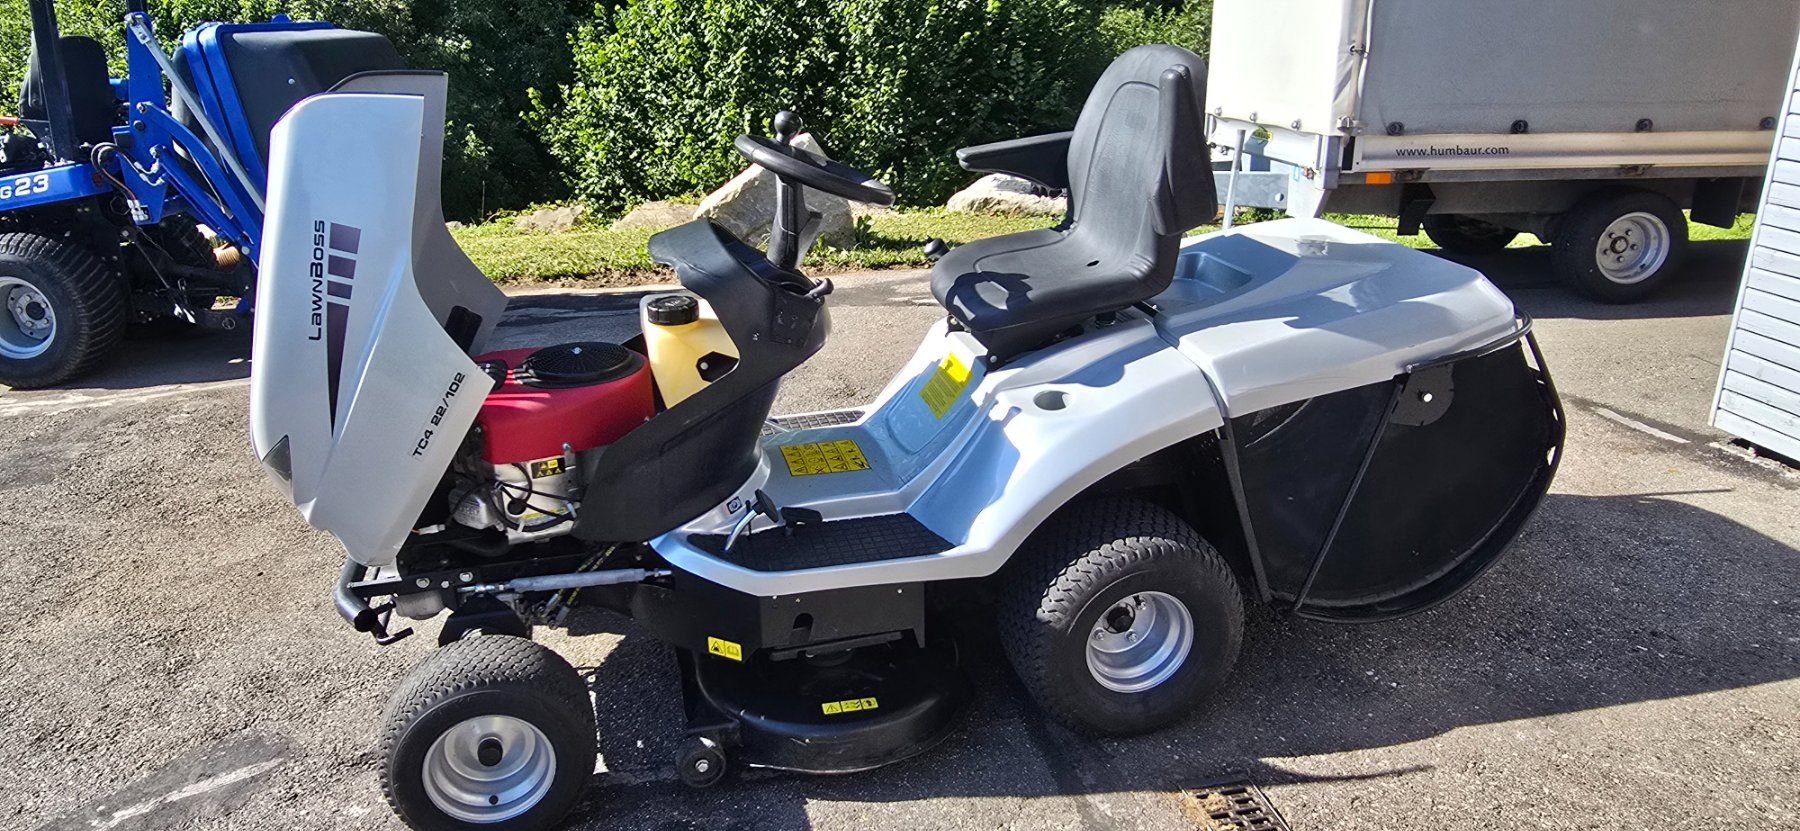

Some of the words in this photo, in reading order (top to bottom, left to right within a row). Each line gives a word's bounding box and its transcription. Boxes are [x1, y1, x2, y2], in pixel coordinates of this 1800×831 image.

[1396, 145, 1509, 156] www.humbaur.com
[412, 429, 434, 456] TC4
[430, 372, 466, 426] 22/102
